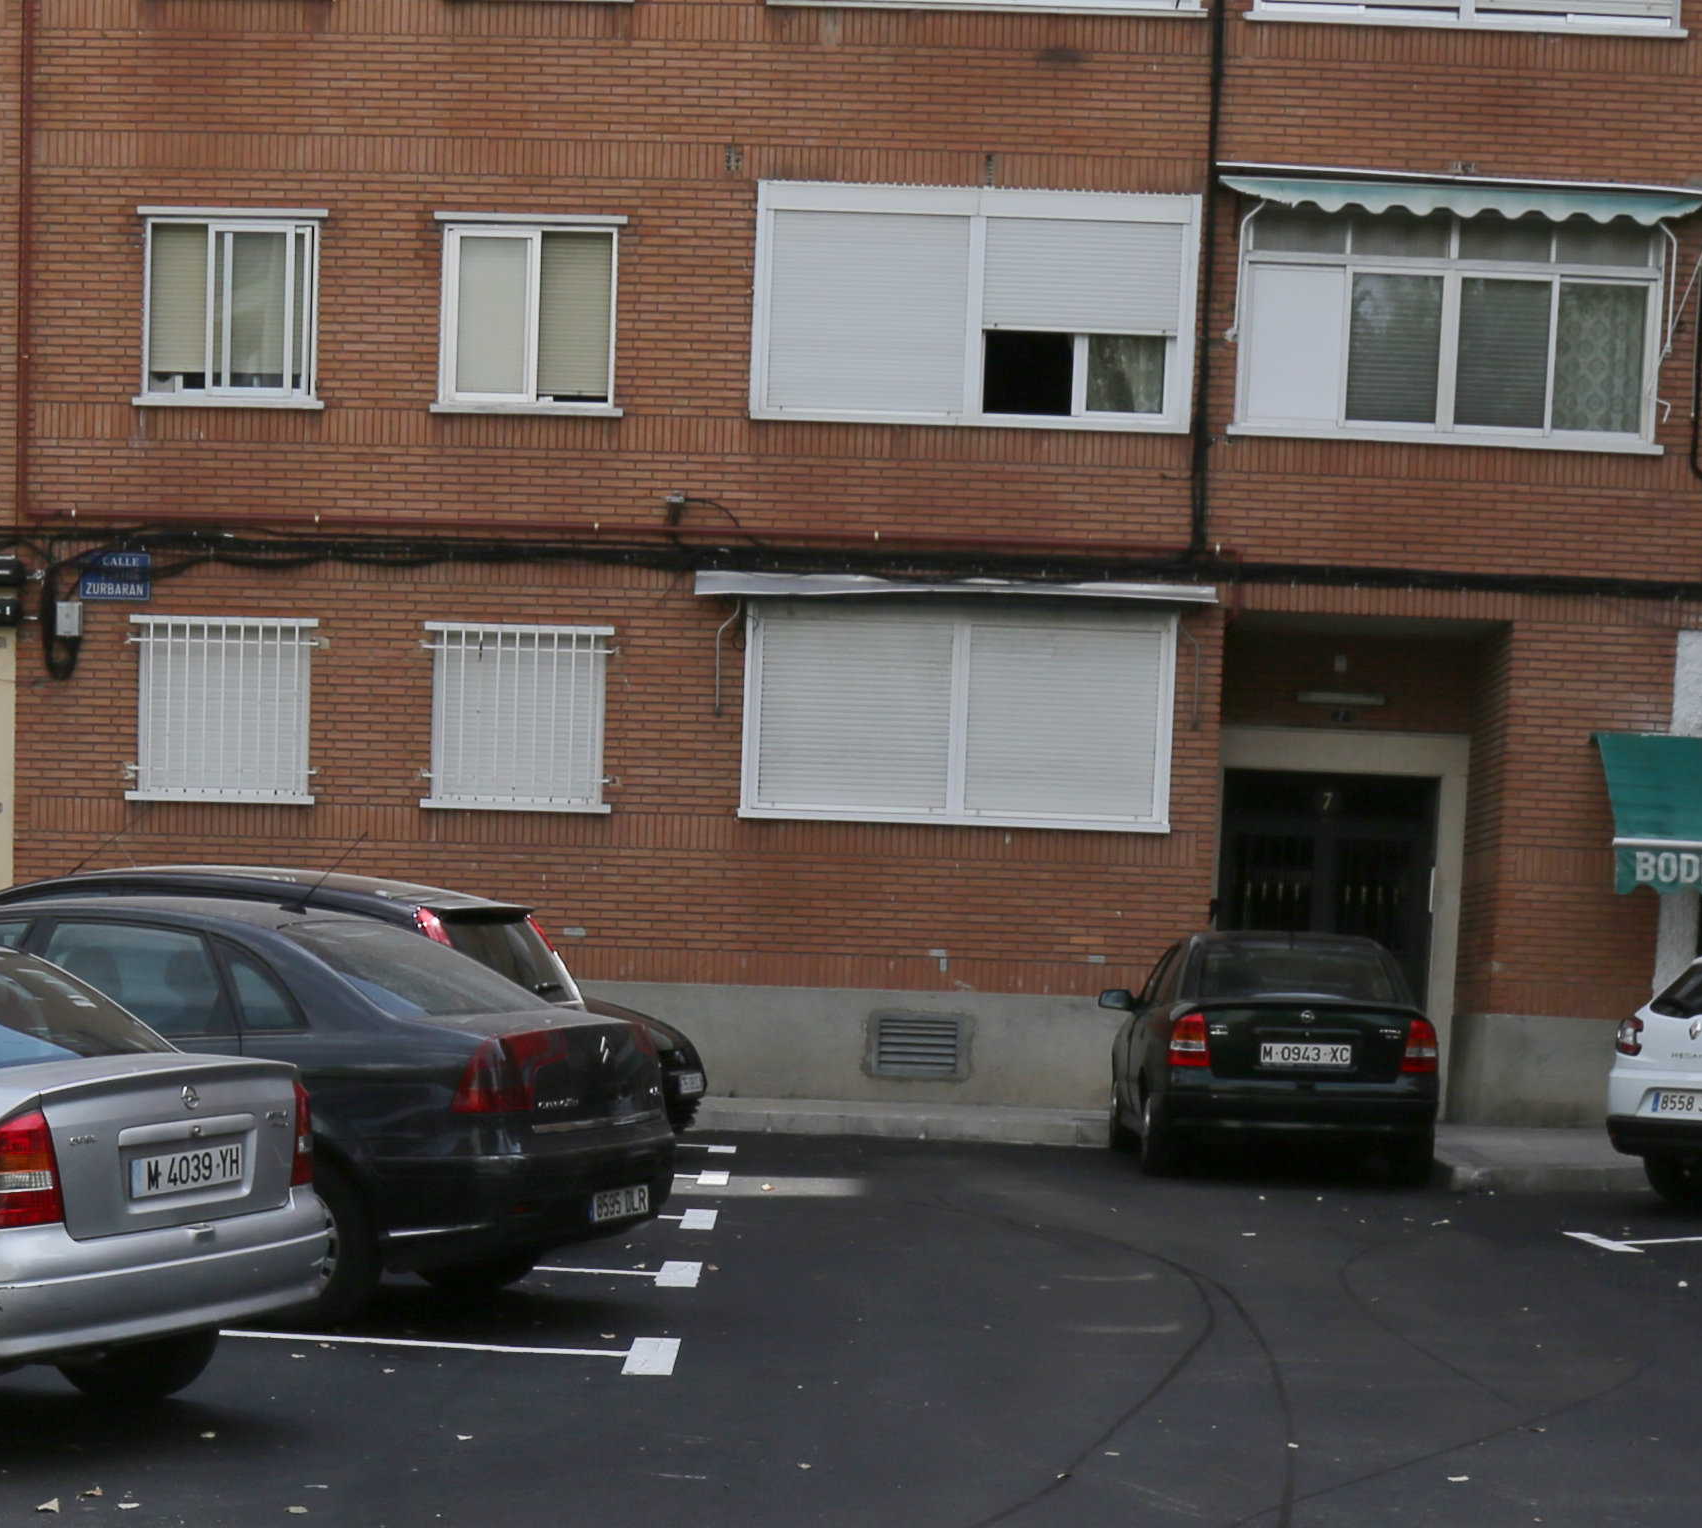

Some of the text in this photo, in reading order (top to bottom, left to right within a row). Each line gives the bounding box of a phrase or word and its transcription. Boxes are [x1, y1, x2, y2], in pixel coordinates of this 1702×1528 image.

[102, 558, 139, 567] CALLE
[85, 583, 143, 596] ZURBARAN
[1323, 792, 1333, 810] 7
[1660, 1094, 1695, 1112] 8558
[167, 1152, 213, 1187] 4039
[219, 1147, 240, 1179] YH
[625, 1187, 647, 1213] DLR
